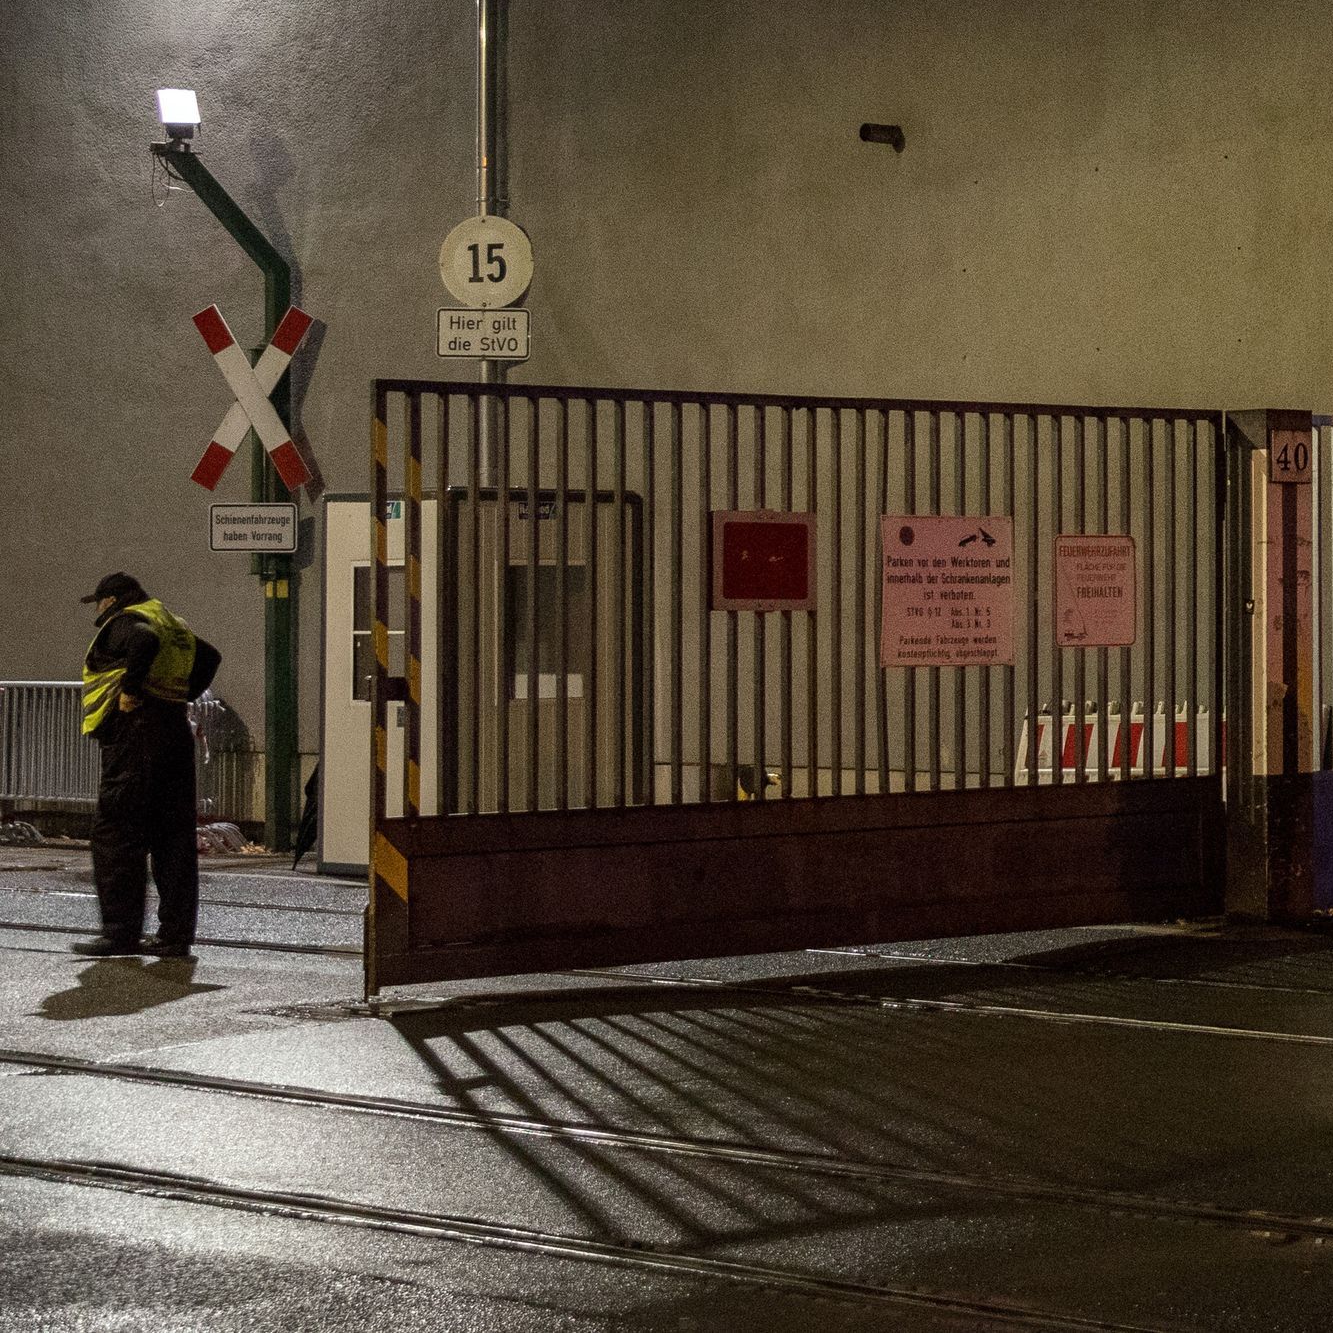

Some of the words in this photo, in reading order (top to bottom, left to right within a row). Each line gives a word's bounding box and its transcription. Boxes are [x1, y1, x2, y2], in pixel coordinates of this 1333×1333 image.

[467, 243, 507, 282] 15
[450, 316, 483, 330] Hier
[492, 317, 517, 334] gilt
[448, 337, 472, 351] die
[480, 337, 518, 352] StVO
[1276, 442, 1308, 471] 40
[215, 514, 291, 527] Schienenfahrzeuge
[223, 531, 248, 541] haben
[251, 531, 283, 543] Vorrang
[887, 556, 914, 567] Parken
[917, 558, 929, 567] vor
[932, 556, 947, 567] den
[951, 557, 991, 567] Werktoren
[995, 557, 1010, 568] und
[887, 572, 923, 584] innerhalb
[926, 572, 939, 584] der
[942, 573, 1010, 586] Schrankenanlagen
[923, 588, 934, 600] ist
[1076, 586, 1123, 599] FREIHALTEN
